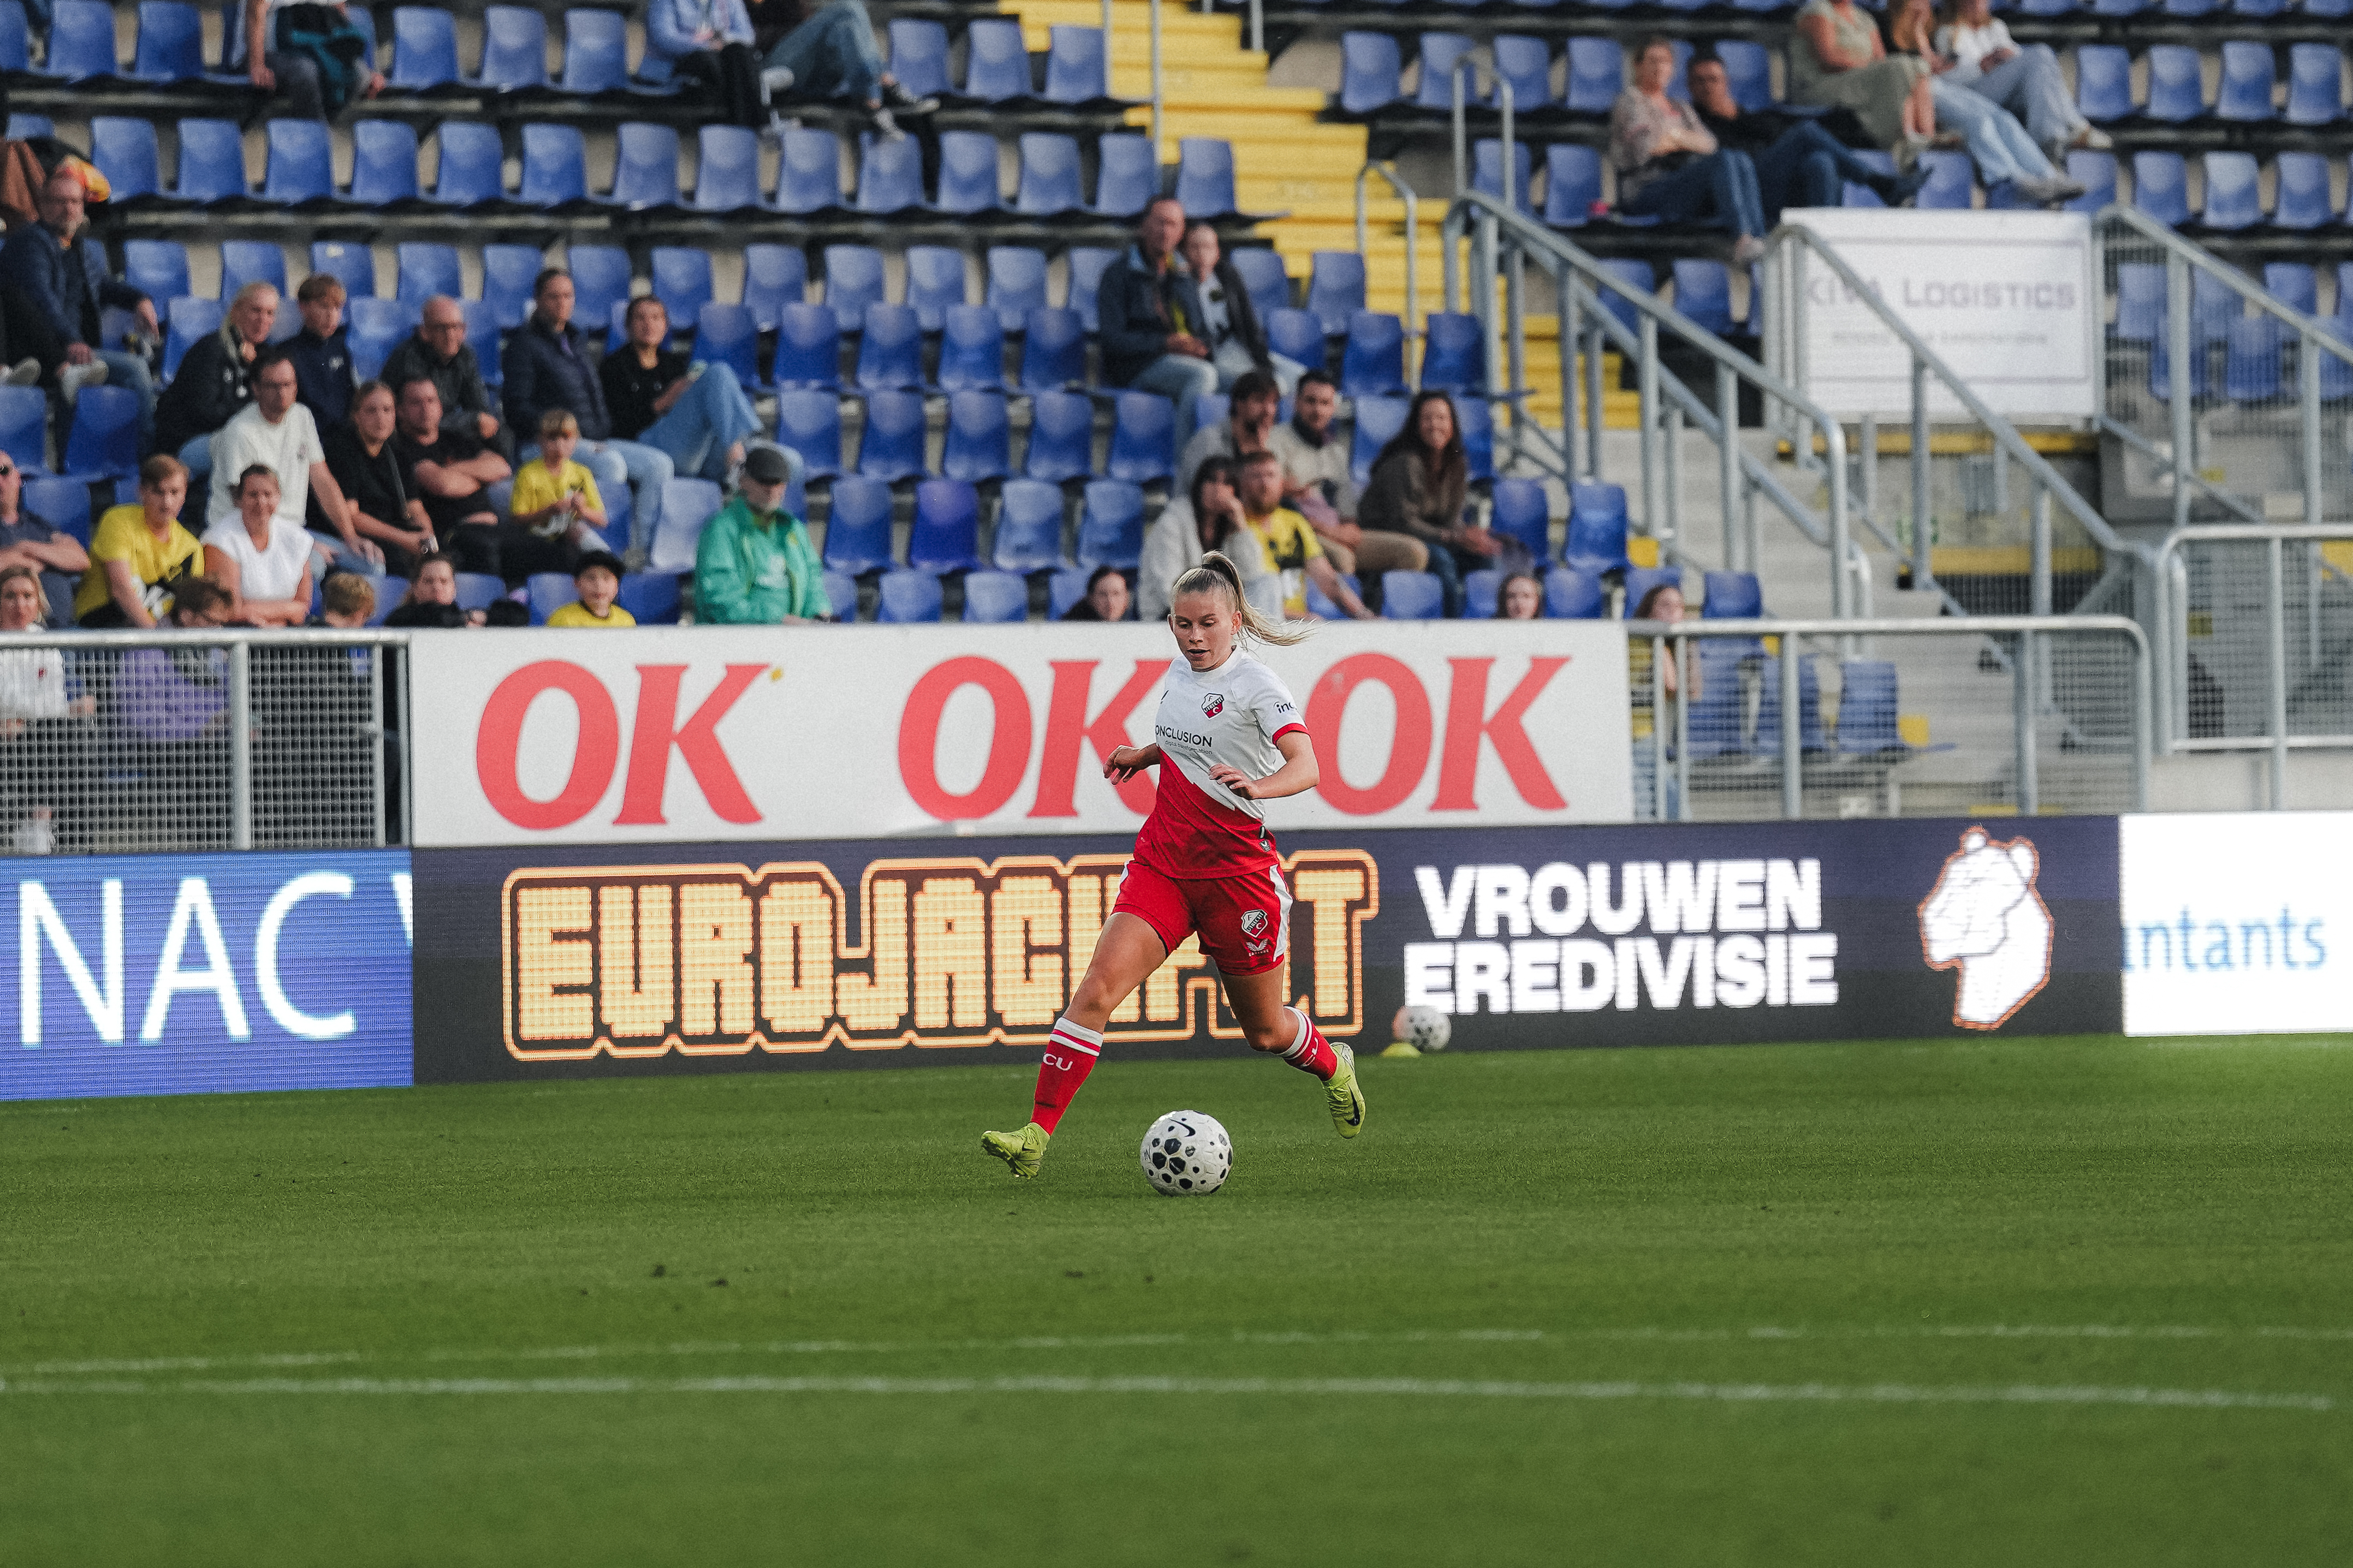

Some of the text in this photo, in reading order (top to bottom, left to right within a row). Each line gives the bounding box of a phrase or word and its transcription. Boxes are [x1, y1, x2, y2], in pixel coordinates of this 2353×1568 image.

[477, 659, 770, 831] OK
[899, 655, 1174, 822] OK
[1305, 652, 1571, 816] OK
[19, 872, 358, 1048] NAC
[1404, 932, 1839, 1015] EREDIVISIE
[1414, 857, 1822, 938] VROUWEN
